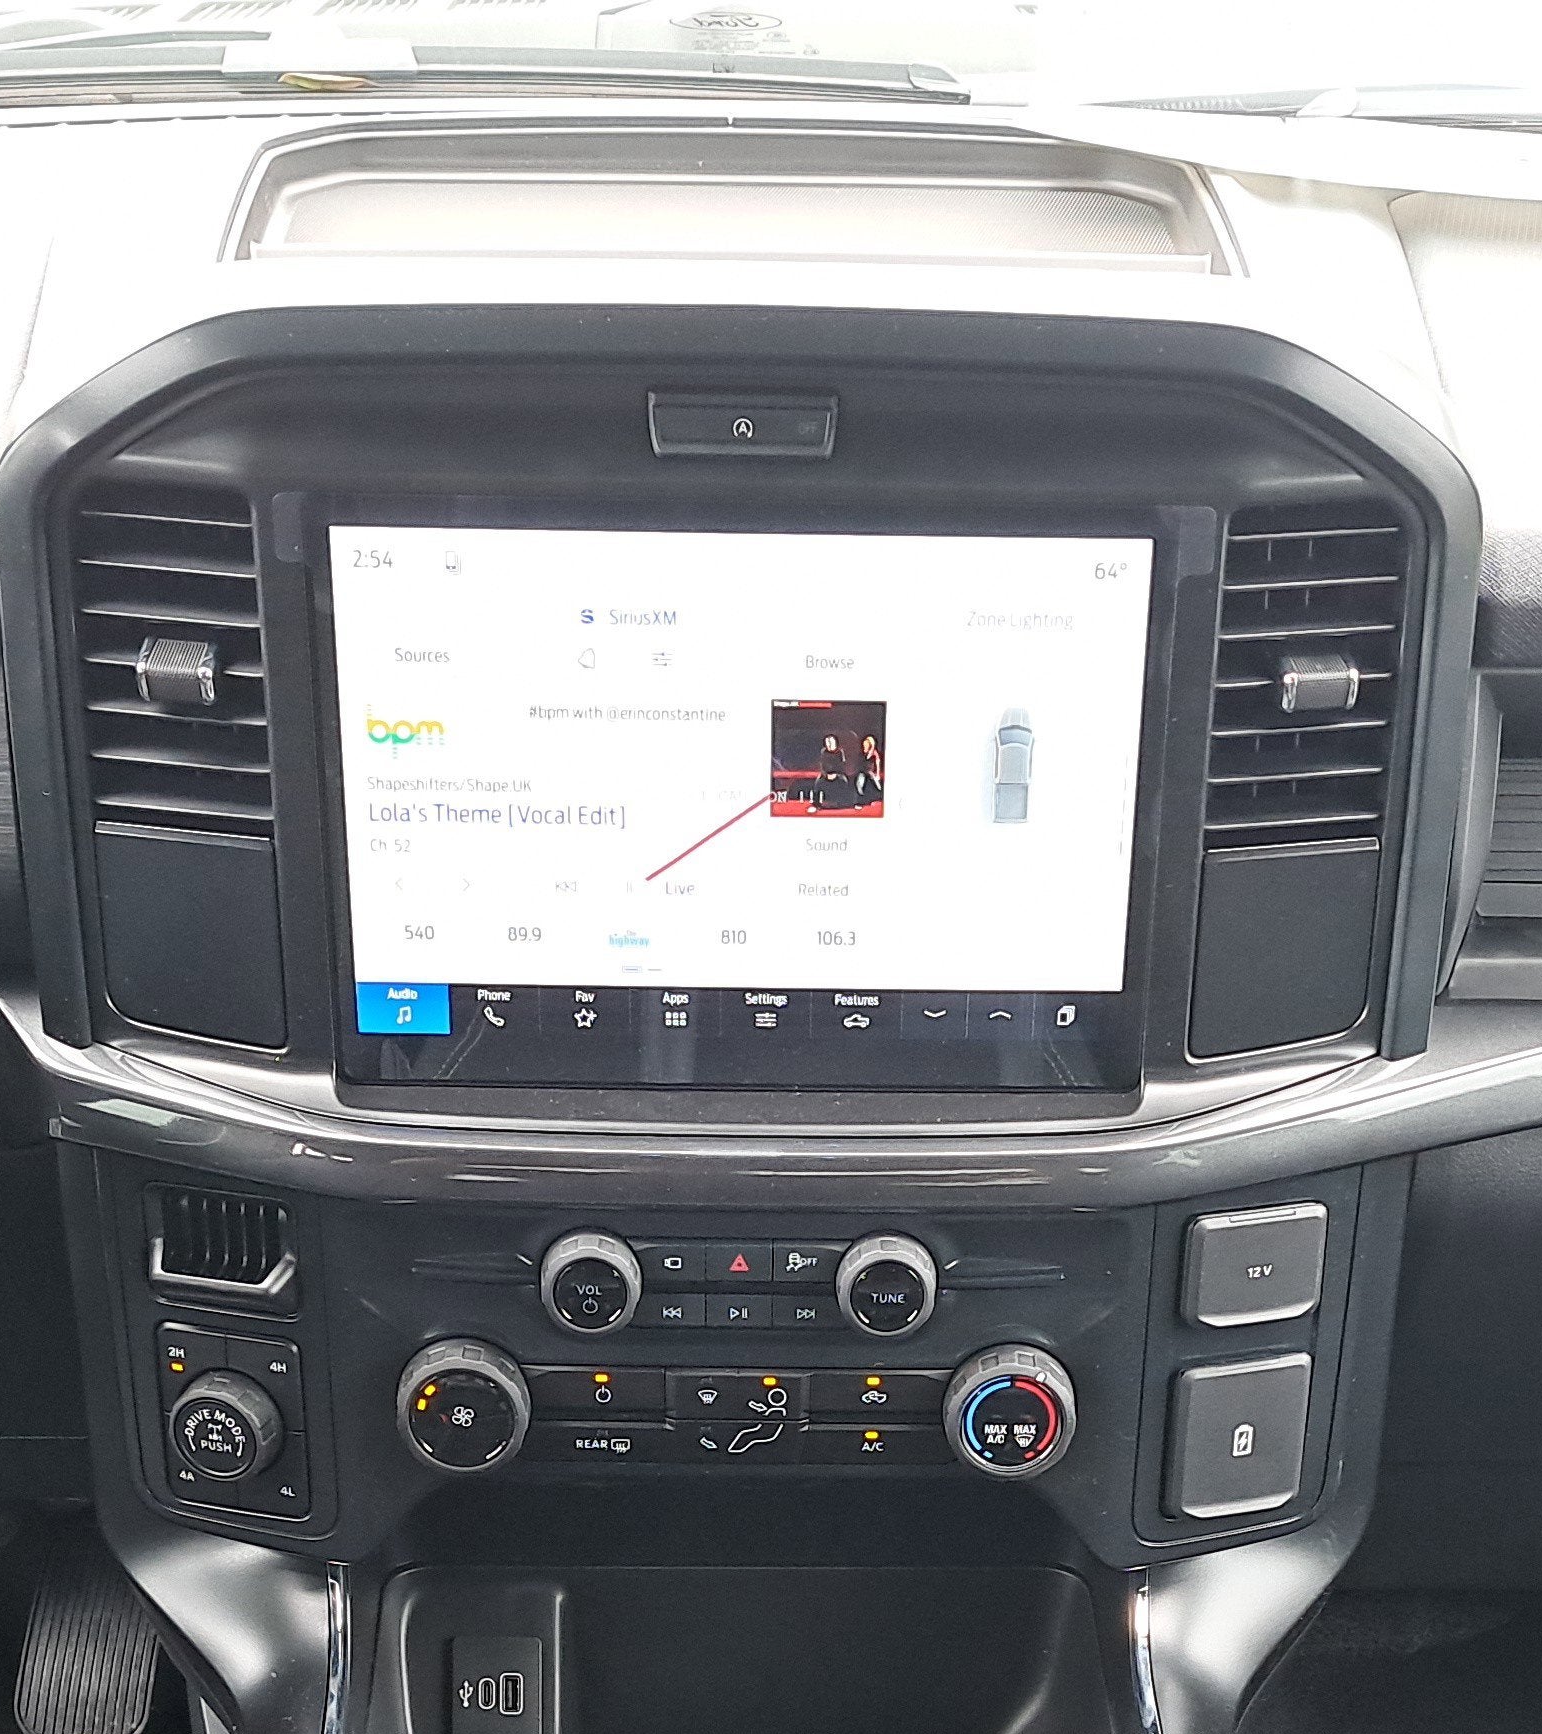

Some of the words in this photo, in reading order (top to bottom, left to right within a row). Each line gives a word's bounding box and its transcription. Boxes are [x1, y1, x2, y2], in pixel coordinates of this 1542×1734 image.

[353, 549, 394, 569] 2:54
[1093, 559, 1129, 581] 64°
[609, 609, 678, 627] SiriusXM
[967, 610, 1006, 627] Zone
[1009, 611, 1074, 631] Lighting
[394, 647, 451, 665] Sources
[805, 654, 855, 670] Browse
[529, 705, 571, 721] #bpm
[573, 706, 604, 720] with
[606, 706, 727, 723] @erinconstantine
[366, 708, 444, 755] bpm
[367, 776, 533, 794] Shapeshifters/Shape.UK
[369, 803, 428, 823] Lola's
[435, 804, 502, 824] Theme
[509, 805, 572, 828] [Vocal
[578, 805, 628, 828] Edit]
[370, 838, 387, 852] Ch
[394, 838, 411, 853] 52
[806, 838, 849, 854] Sound
[665, 881, 696, 897] Live
[798, 882, 849, 898] Related
[404, 925, 436, 941] 540
[507, 926, 543, 943] 89.9
[608, 932, 650, 949] highway
[721, 929, 747, 945] 810
[817, 930, 857, 947] 106.3
[386, 988, 419, 1002] Audio
[477, 989, 512, 1004] Phone
[574, 991, 596, 1005] Fav
[662, 992, 690, 1007] Apps
[745, 992, 789, 1008] Settings
[834, 993, 880, 1008] Features
[800, 1256, 818, 1268] OFF
[575, 1285, 603, 1297] VOL
[870, 1293, 905, 1304] TUNE
[168, 1346, 185, 1359] 2H
[269, 1361, 287, 1374] 4H
[184, 1409, 211, 1437] DRIVE
[214, 1409, 246, 1443] MODE
[985, 1424, 1007, 1435] MAX
[1014, 1424, 1036, 1435] MAX
[201, 1440, 233, 1453] PUSH
[576, 1438, 608, 1450] REAR
[861, 1441, 884, 1452] A/C
[986, 1434, 1005, 1444] A/C
[179, 1470, 195, 1482] 4A
[279, 1486, 296, 1497] 4L
